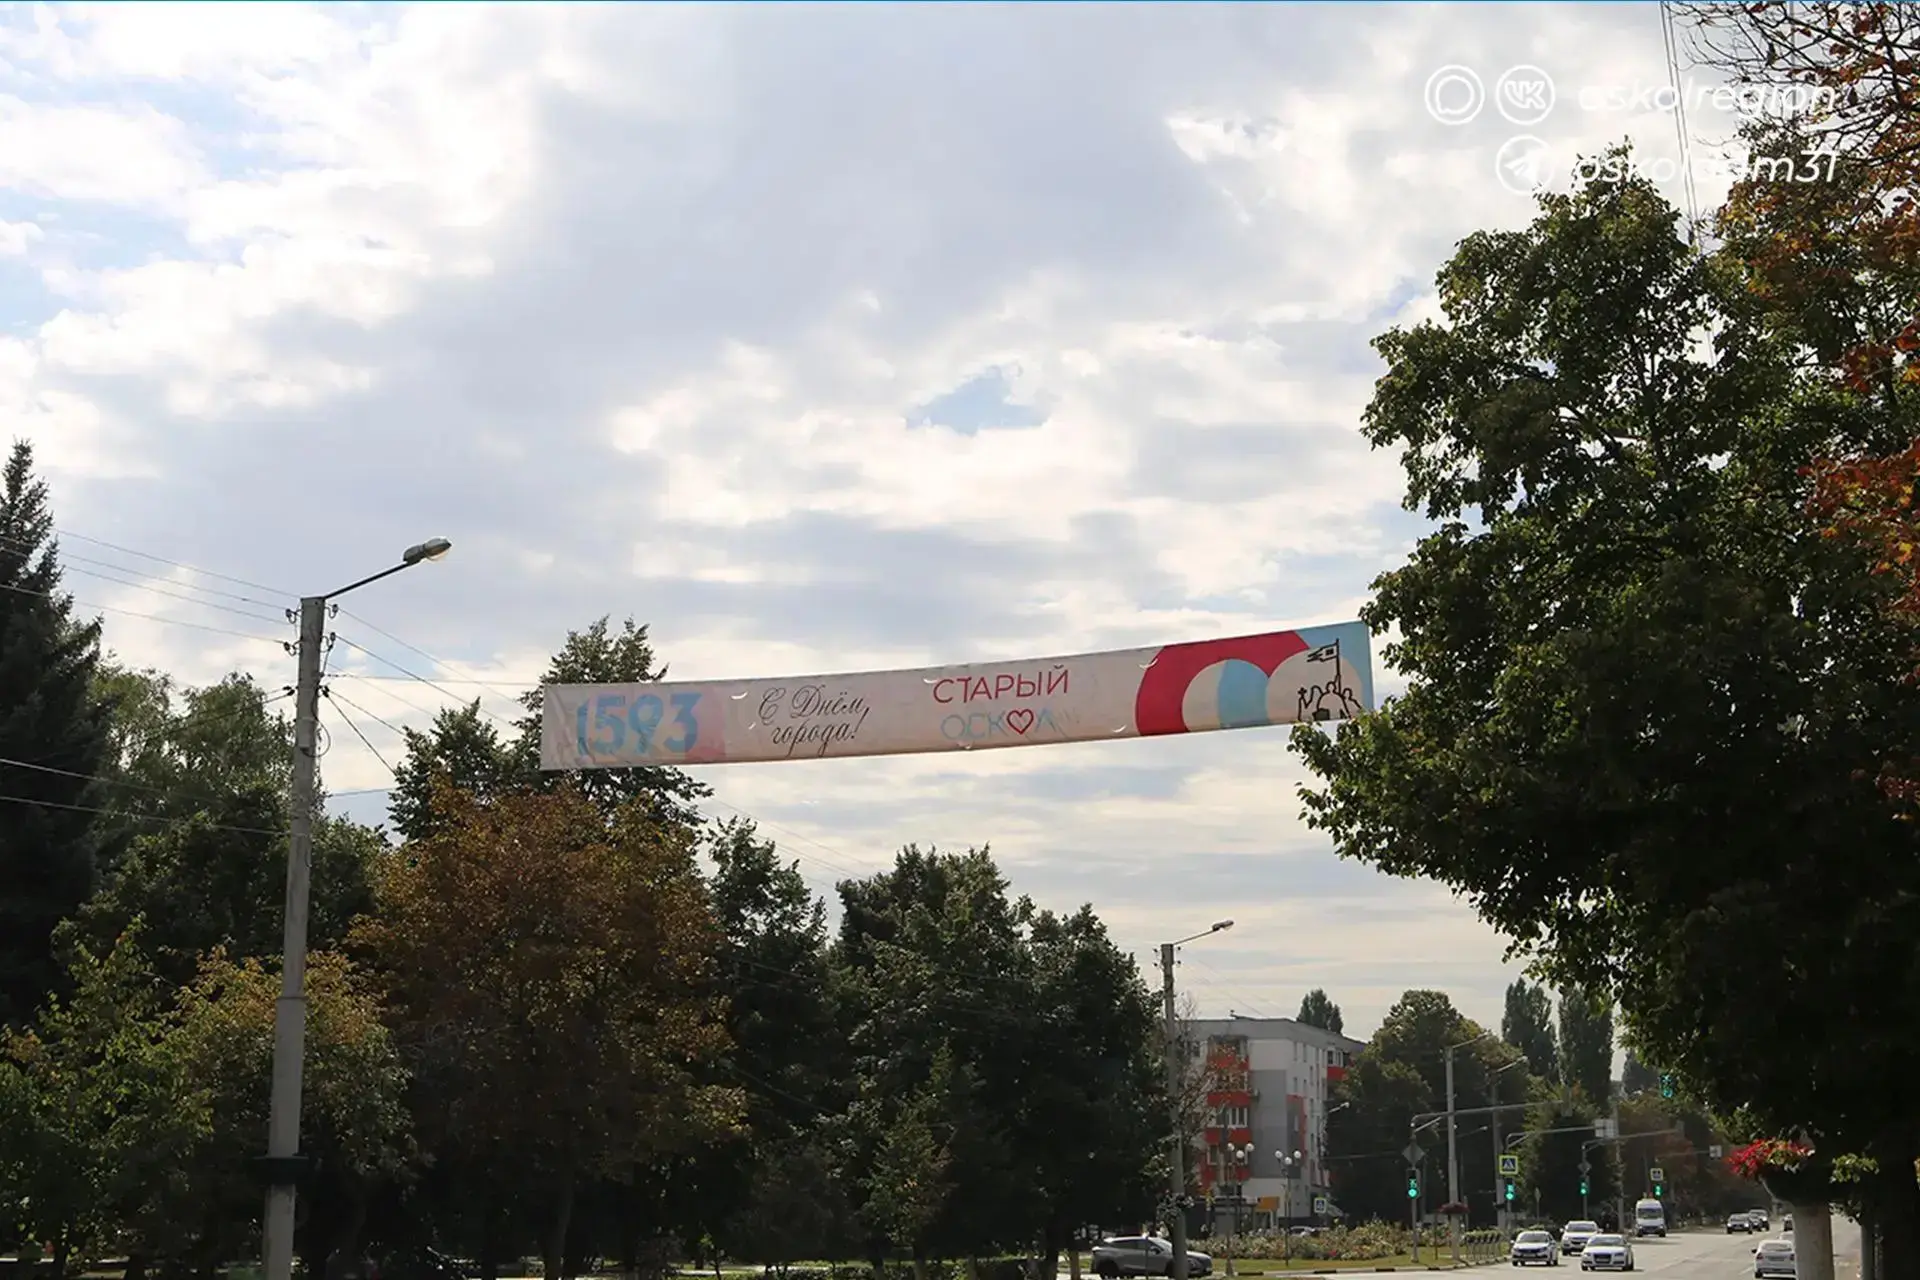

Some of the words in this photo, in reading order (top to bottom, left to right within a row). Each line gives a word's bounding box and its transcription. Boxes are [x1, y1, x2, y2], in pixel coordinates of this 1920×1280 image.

[933, 664, 1068, 703] СТАРЫЙ
[577, 693, 702, 755] 1593
[758, 687, 786, 726] С
[790, 684, 864, 718] Днём
